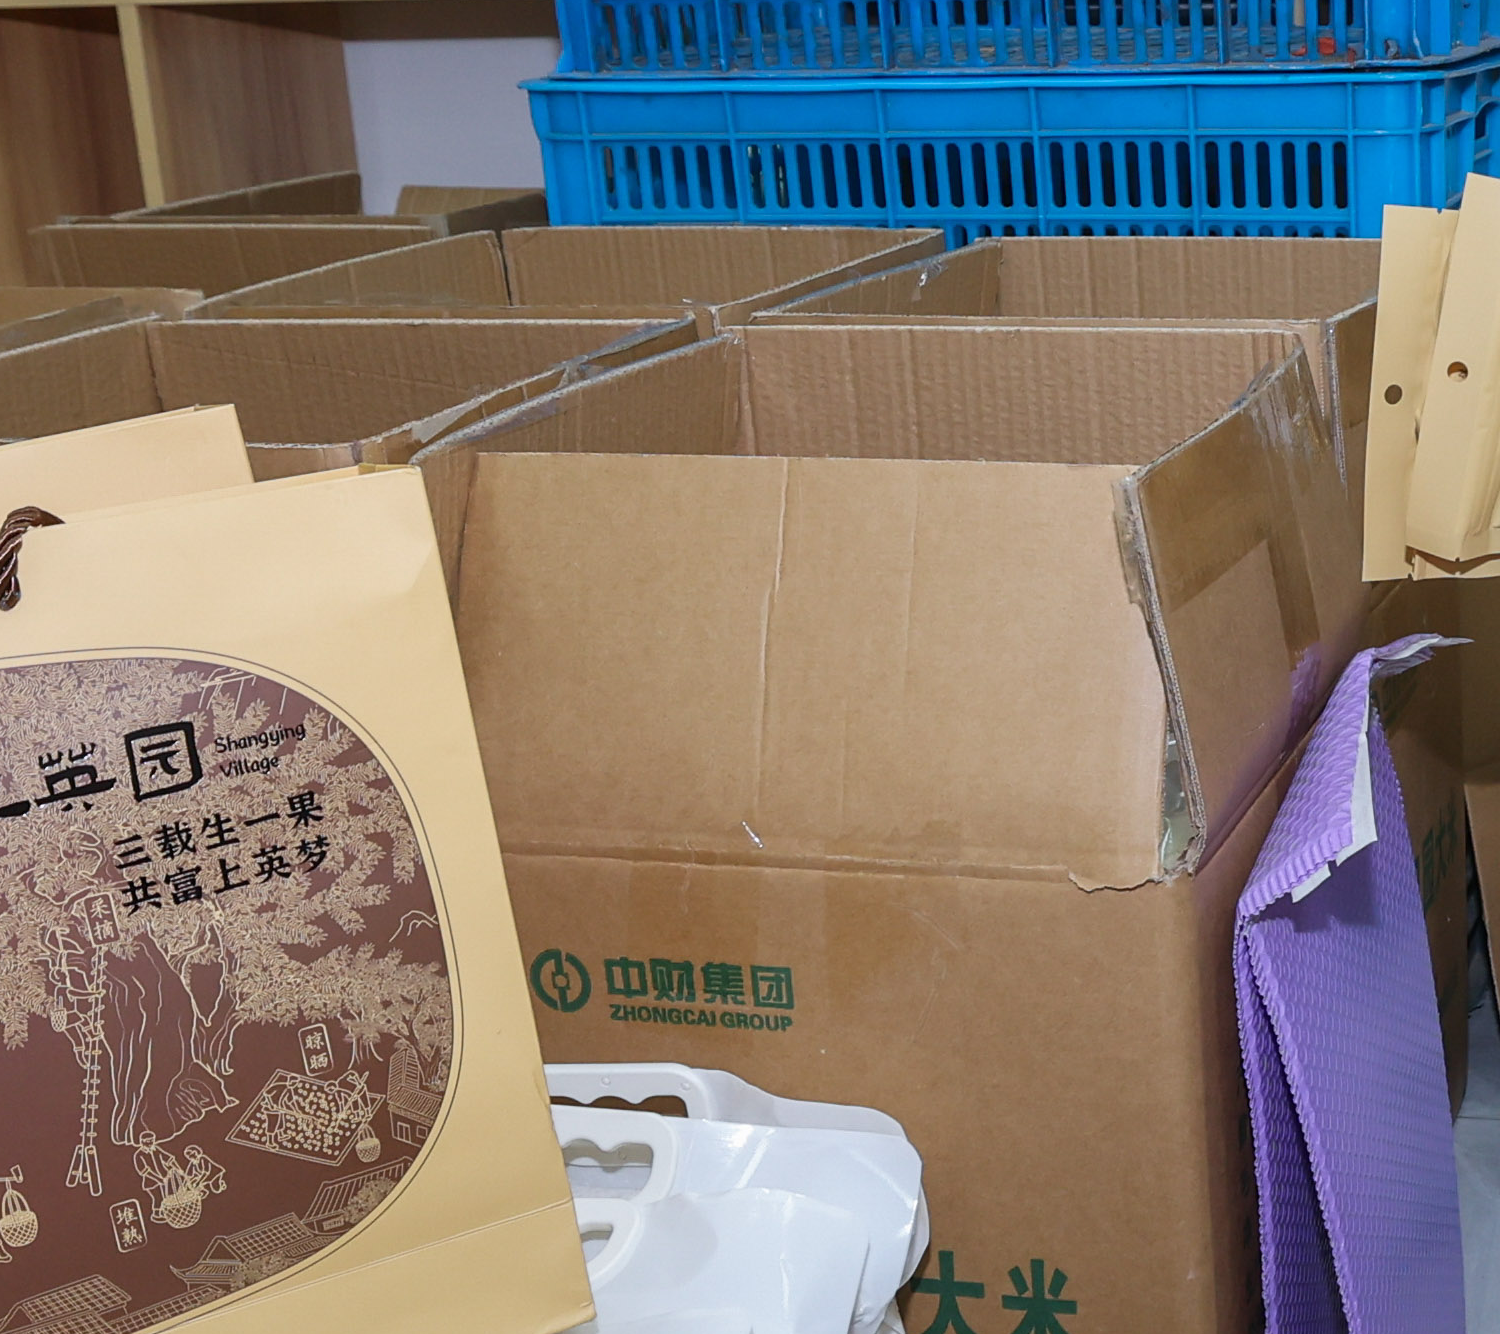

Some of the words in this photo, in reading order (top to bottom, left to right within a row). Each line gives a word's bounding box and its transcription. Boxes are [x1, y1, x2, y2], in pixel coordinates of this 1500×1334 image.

[214, 722, 308, 755] Shangying
[218, 753, 281, 779] Village
[115, 790, 326, 871] 三载生一果
[122, 834, 333, 917] 共富上英梦
[90, 898, 116, 942] 采摘
[604, 956, 795, 1011] 中财集团
[609, 1004, 717, 1028] ZHONGCAI
[720, 1010, 794, 1033] GROUP
